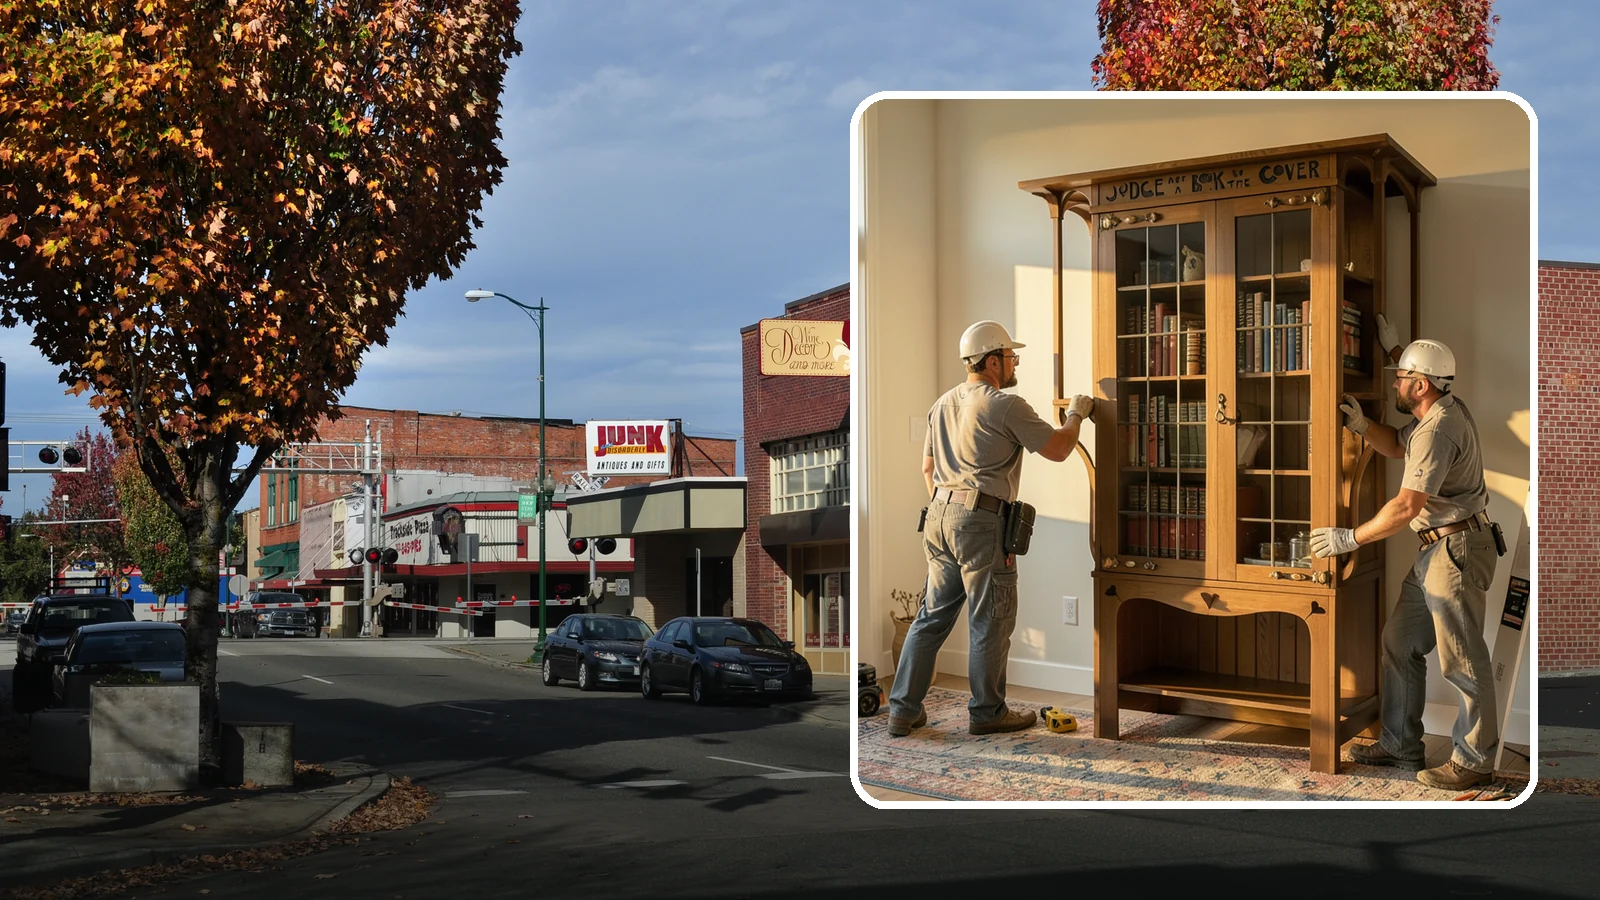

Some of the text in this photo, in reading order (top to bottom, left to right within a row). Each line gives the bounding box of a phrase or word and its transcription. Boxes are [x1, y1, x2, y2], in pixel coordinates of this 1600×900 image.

[1106, 178, 1165, 202] JUDGE
[1258, 160, 1320, 184] COVER
[595, 425, 665, 457] JUNK
[607, 446, 646, 454] DISORDERLY
[596, 460, 665, 470] ANTIQUES AND GIFTS
[573, 473, 588, 492] RAIL
[590, 476, 608, 491] SING
[352, 498, 365, 511] CRO
[414, 519, 429, 535] Pizza
